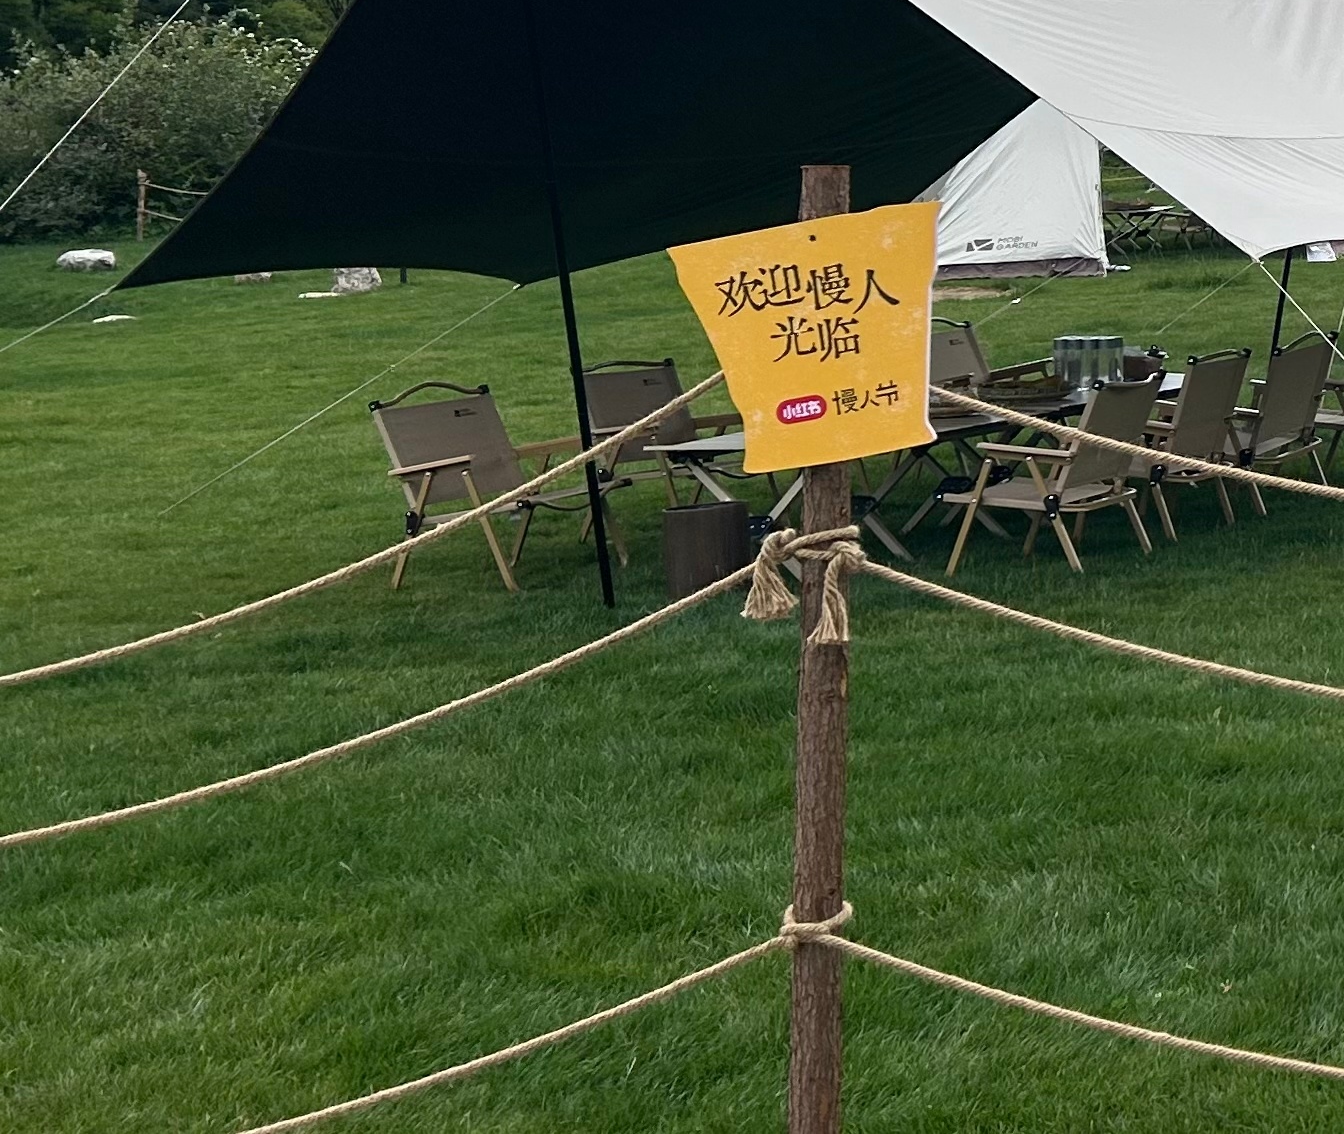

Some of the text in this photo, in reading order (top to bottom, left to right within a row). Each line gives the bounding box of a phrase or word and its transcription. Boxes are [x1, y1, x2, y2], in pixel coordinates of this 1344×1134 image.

[996, 241, 1039, 250] GARDEN
[715, 263, 900, 317] 欢迎慢人
[770, 316, 860, 362] 光临
[782, 380, 899, 420] 小红书 慢人节
